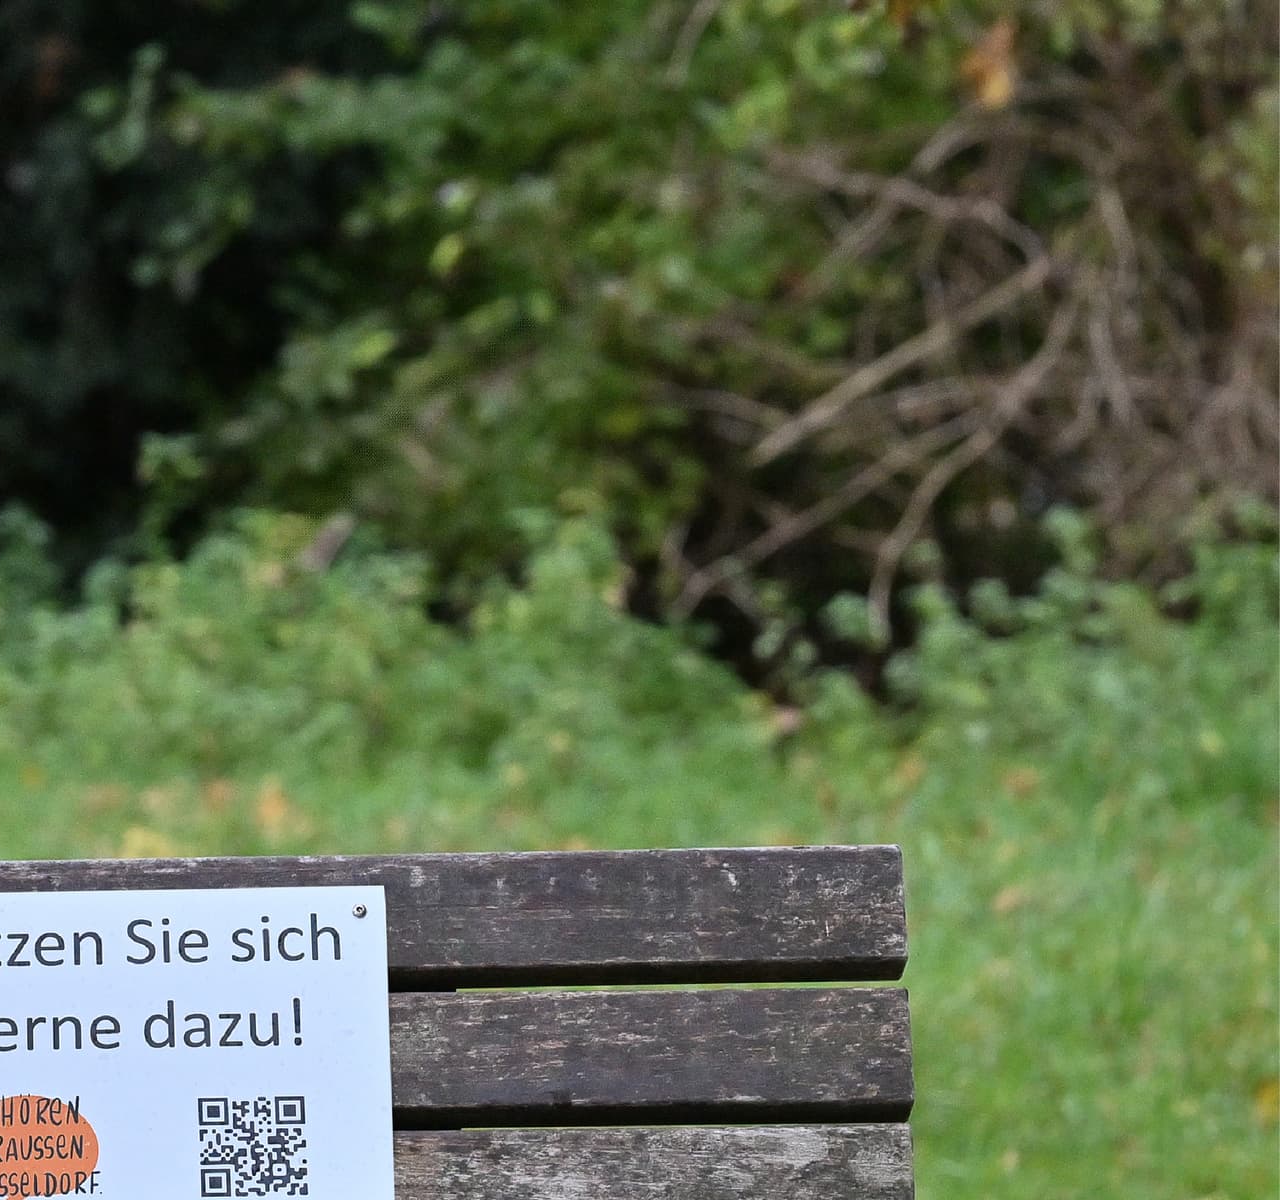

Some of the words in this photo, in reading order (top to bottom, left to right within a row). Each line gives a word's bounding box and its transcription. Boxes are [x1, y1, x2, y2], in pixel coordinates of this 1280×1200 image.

[126, 917, 209, 965] Sie
[231, 912, 342, 962] sich
[143, 997, 304, 1049] dazu!
